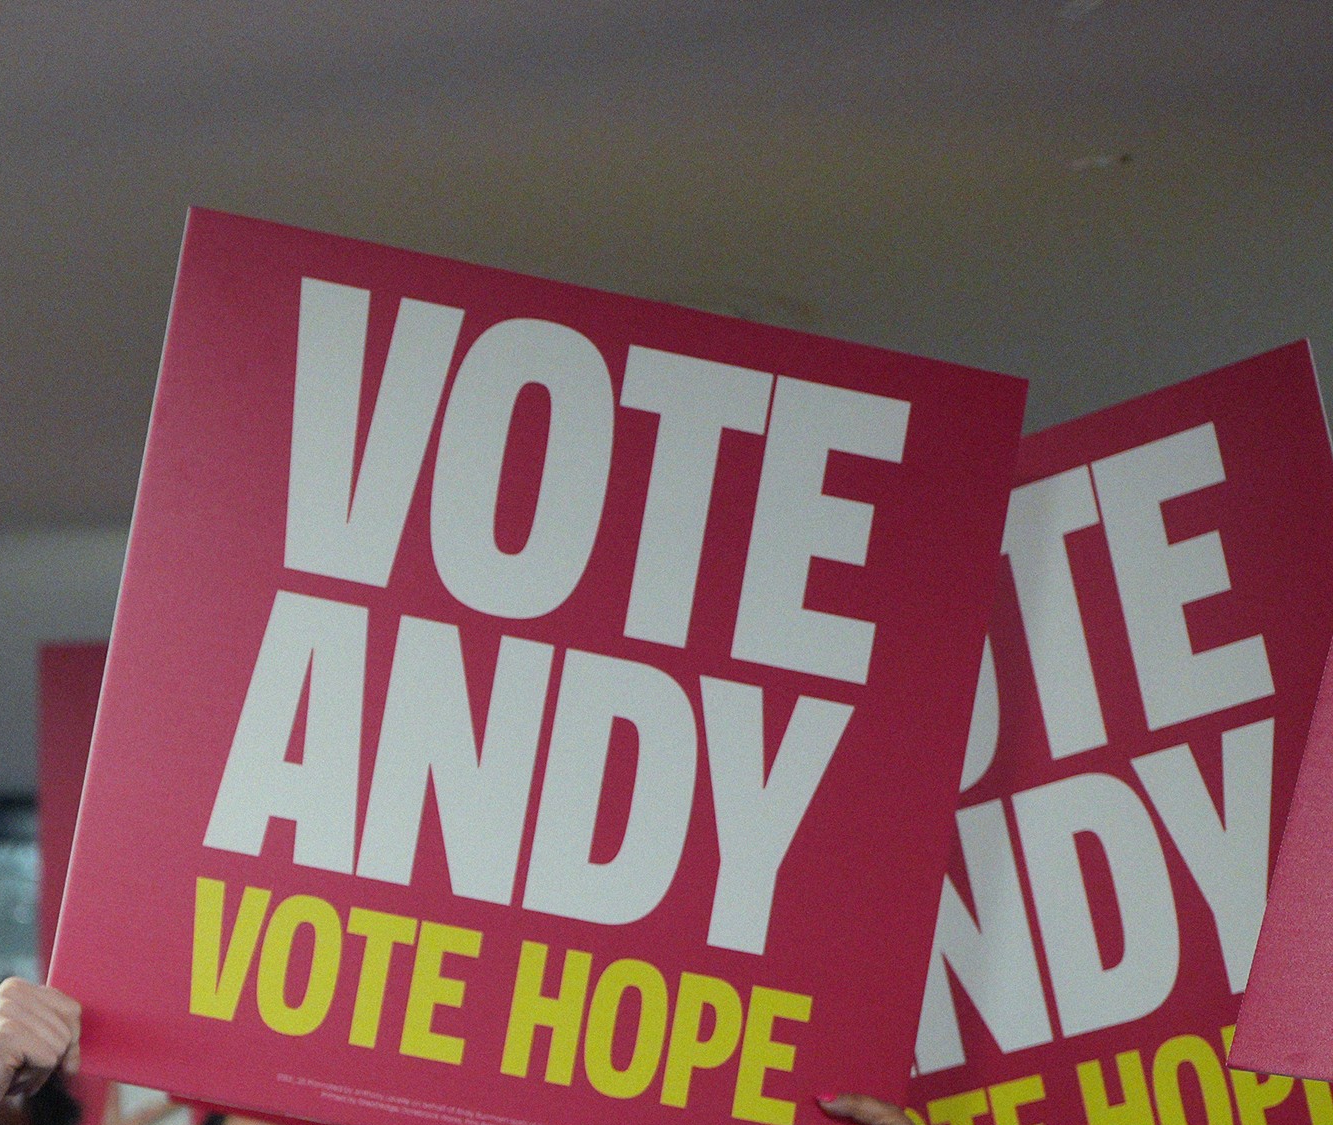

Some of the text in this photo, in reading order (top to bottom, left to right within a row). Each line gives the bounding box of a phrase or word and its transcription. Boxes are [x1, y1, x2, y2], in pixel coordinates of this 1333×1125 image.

[283, 276, 912, 685] VOTE
[960, 421, 1276, 793] TE
[202, 588, 855, 957] ANDY
[910, 717, 1276, 1078] NDY
[189, 876, 484, 1066] VOTE
